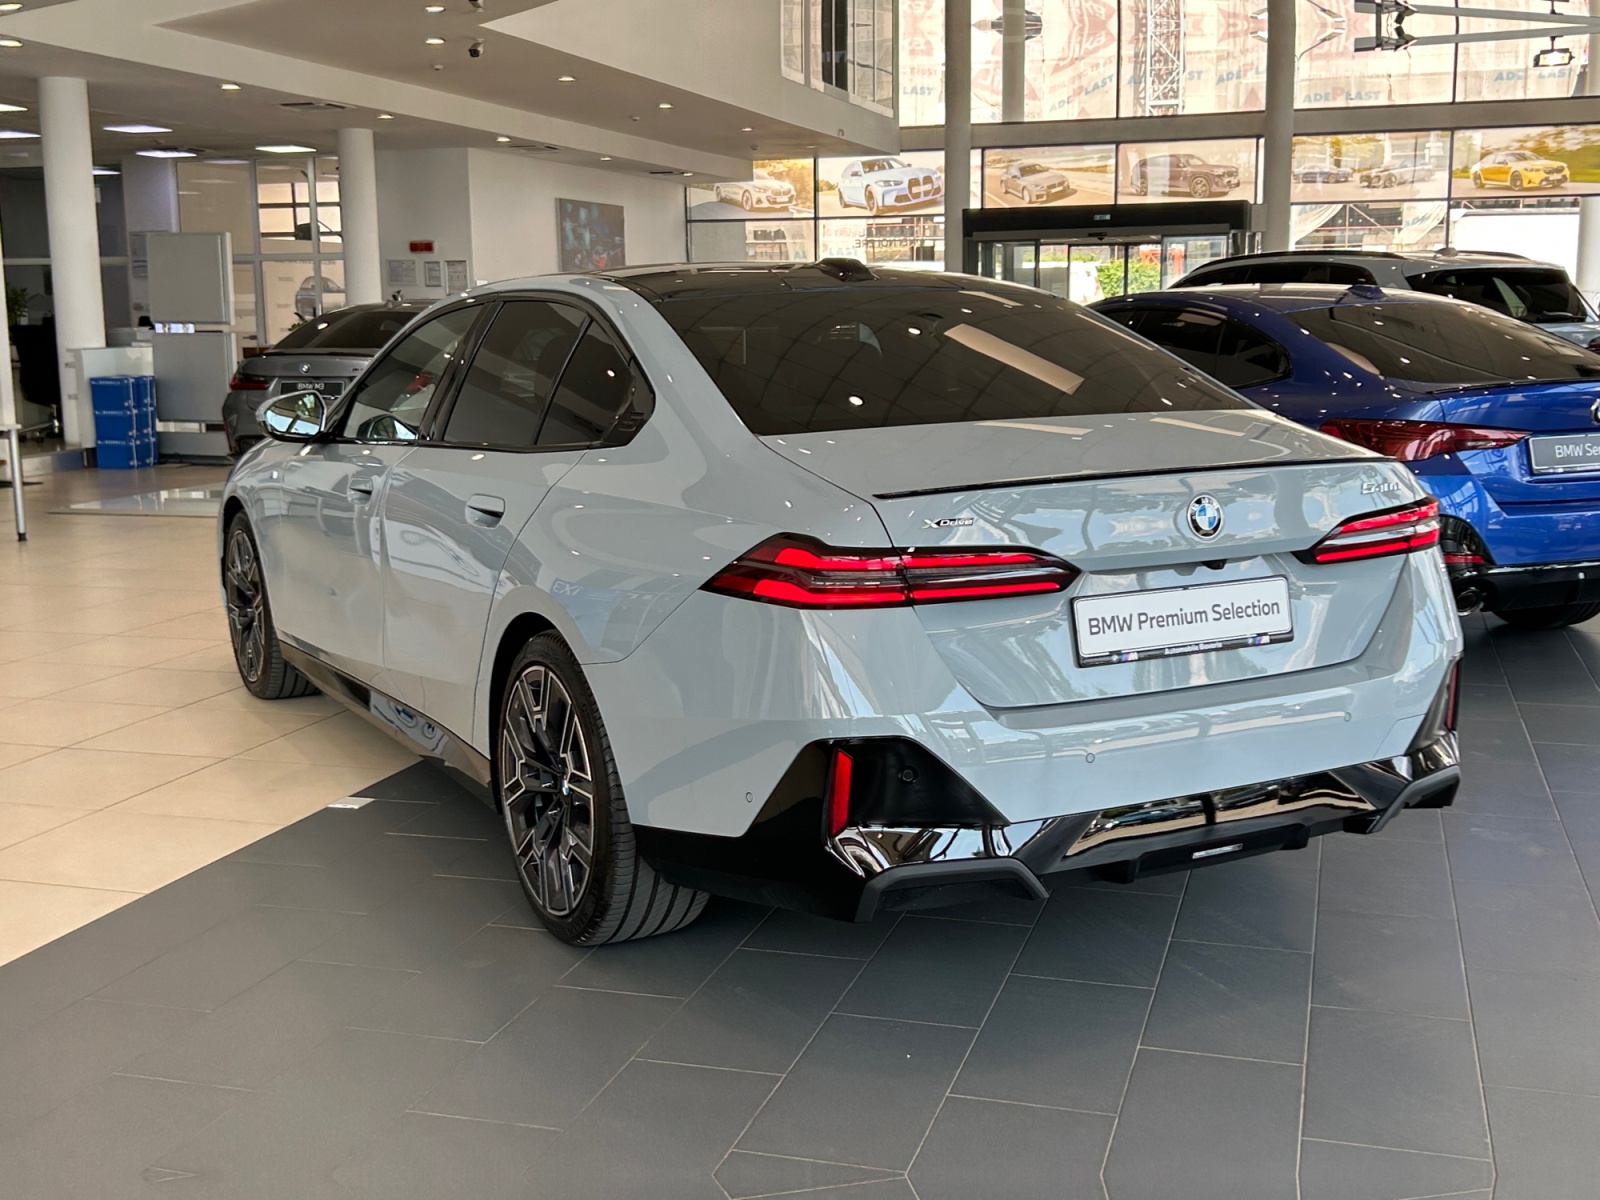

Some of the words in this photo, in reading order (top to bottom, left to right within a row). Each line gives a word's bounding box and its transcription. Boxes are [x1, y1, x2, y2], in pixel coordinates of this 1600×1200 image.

[1494, 67, 1573, 82] ADELAST
[1302, 86, 1381, 104] ADEPLAST
[314, 382, 325, 390] M3
[1555, 444, 1583, 458] BMW
[1088, 613, 1133, 636] BMW
[1138, 608, 1209, 630] Premium
[1211, 599, 1281, 622] Selection
